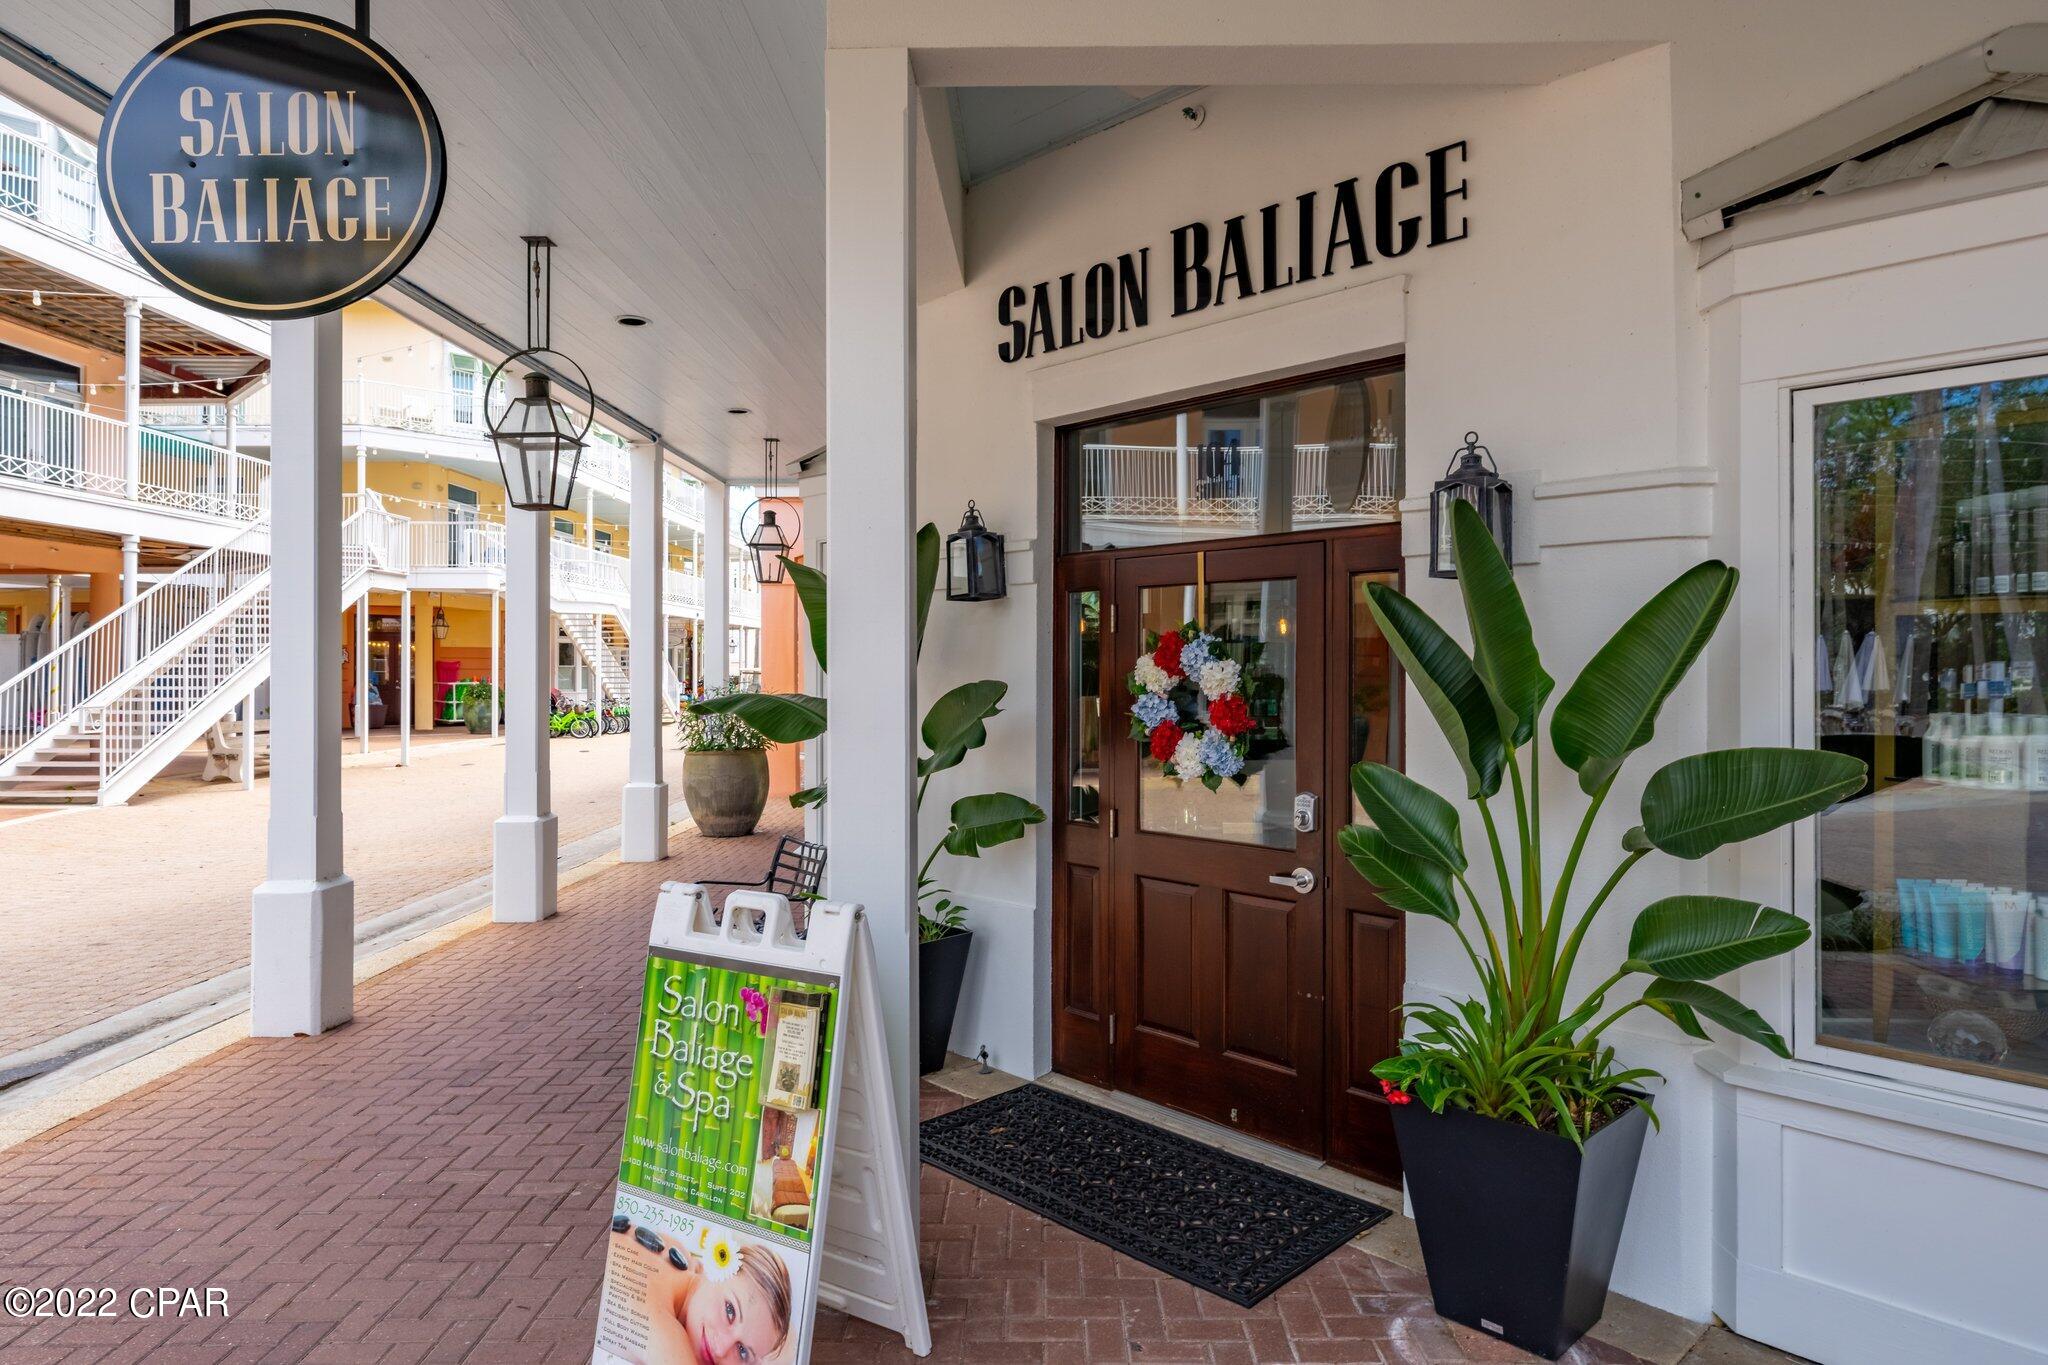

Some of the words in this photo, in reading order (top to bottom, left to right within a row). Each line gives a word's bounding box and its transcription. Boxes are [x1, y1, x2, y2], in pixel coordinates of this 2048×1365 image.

[179, 86, 357, 157] SALON
[149, 172, 392, 244] BALIAGE
[997, 246, 1151, 364] SALON
[1169, 139, 1469, 319] BALIAGE
[657, 975, 740, 1027] Salon
[650, 1018, 754, 1089] Baliage
[654, 1071, 673, 1098] &
[671, 1070, 731, 1134] Spa
[632, 1134, 749, 1177] www.salonbaliage.com
[616, 1195, 695, 1236] 850-235-1985
[690, 1188, 724, 1204] CARILLON
[729, 1188, 746, 1199] 202
